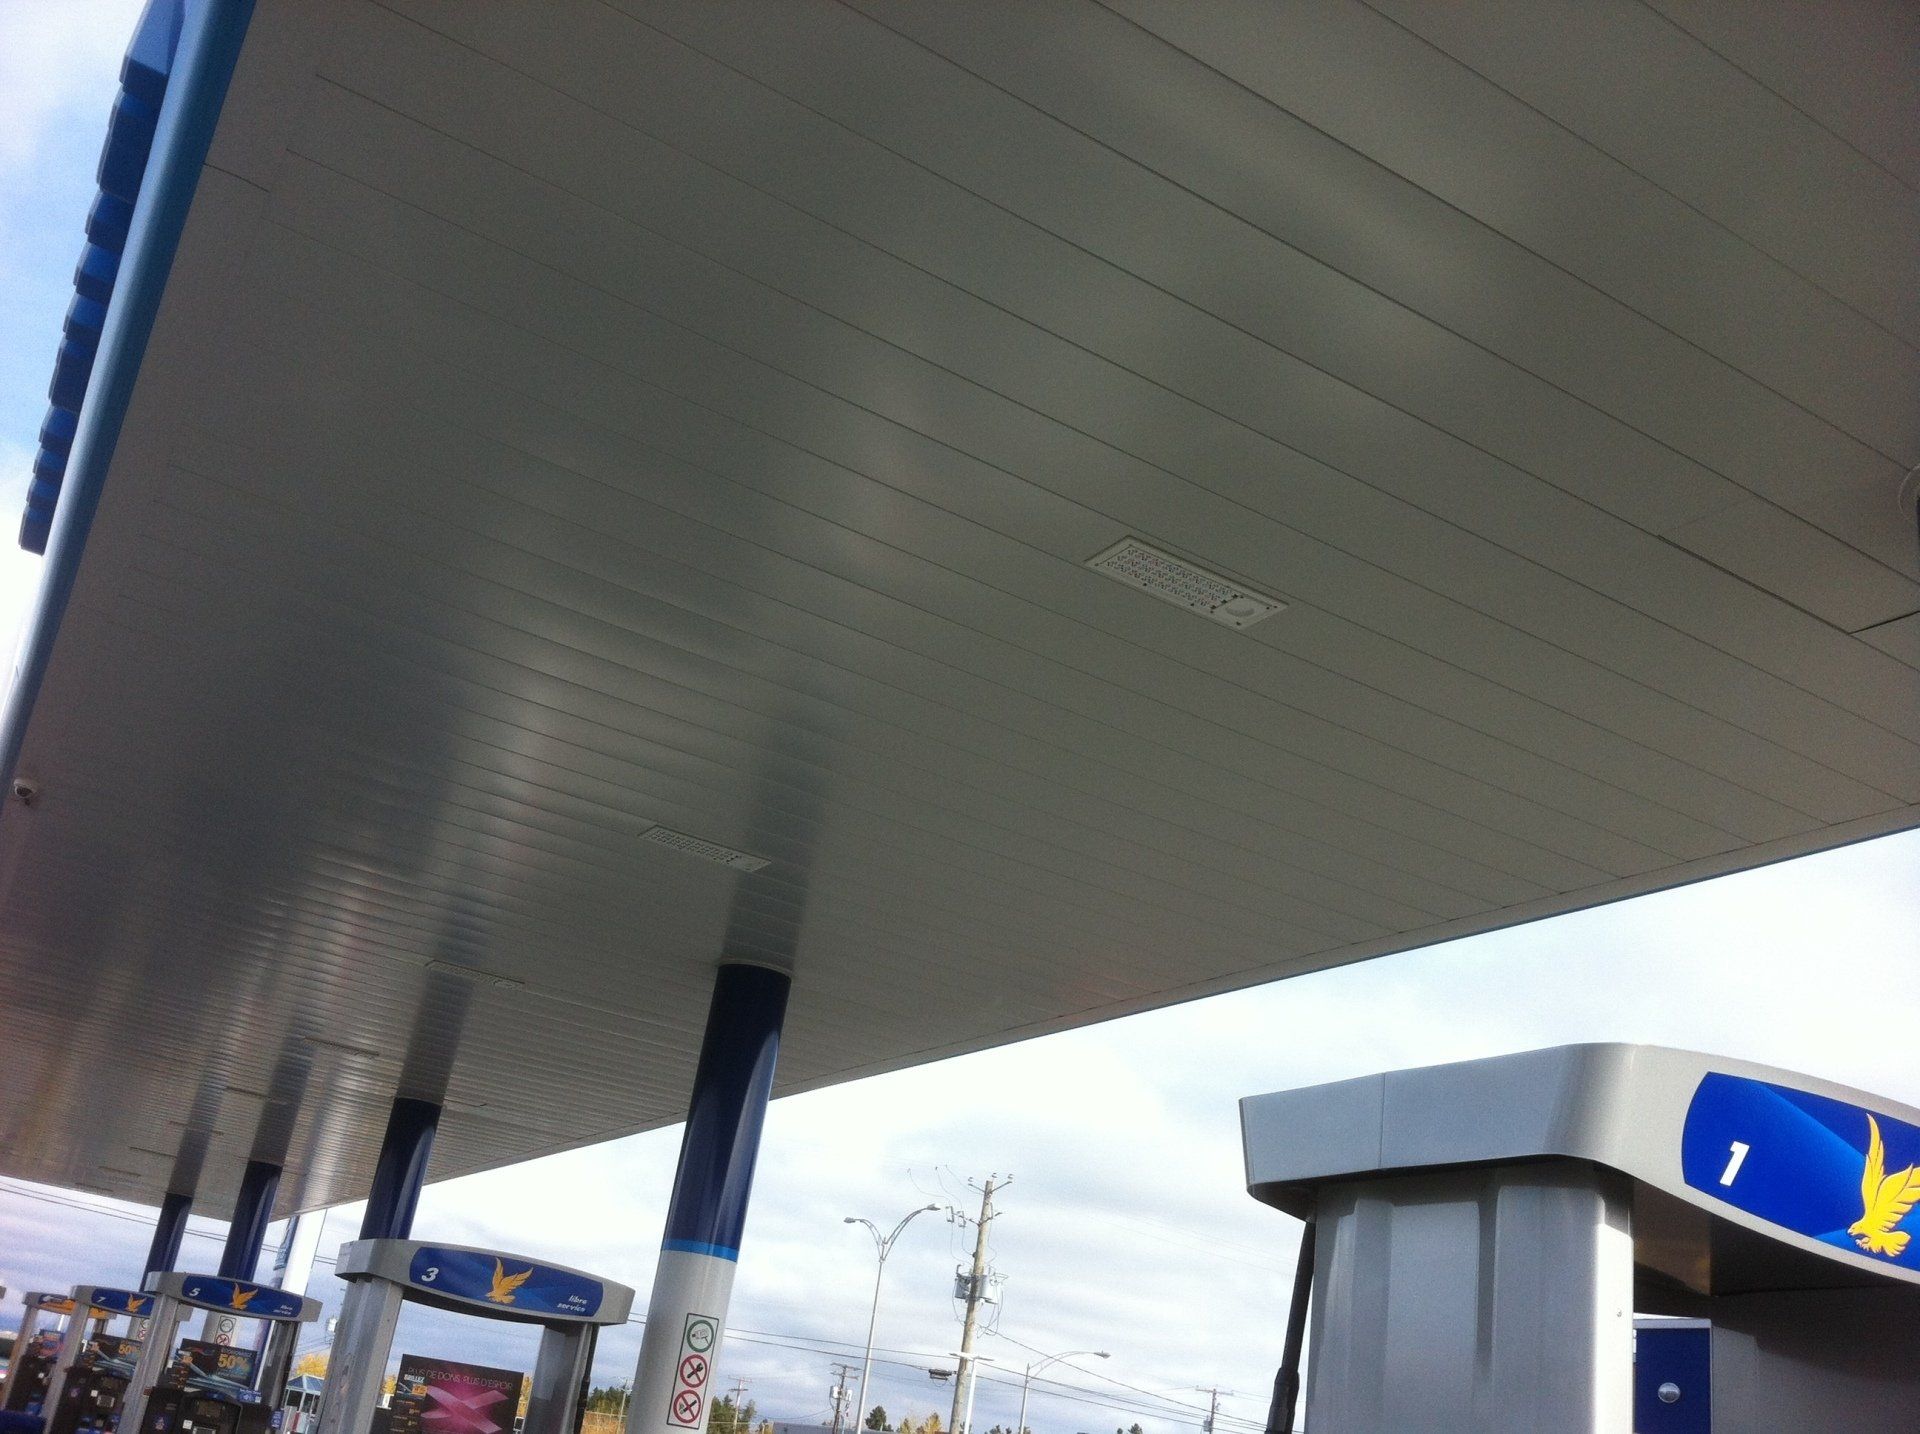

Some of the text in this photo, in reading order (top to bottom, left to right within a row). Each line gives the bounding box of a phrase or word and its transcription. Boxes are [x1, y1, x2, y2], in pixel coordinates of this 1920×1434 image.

[1719, 1140, 1750, 1187] 1
[421, 1267, 439, 1282] 3
[189, 1287, 200, 1297] 5
[568, 1294, 588, 1305] libre
[556, 1302, 586, 1312] service
[426, 1369, 437, 1379] DE
